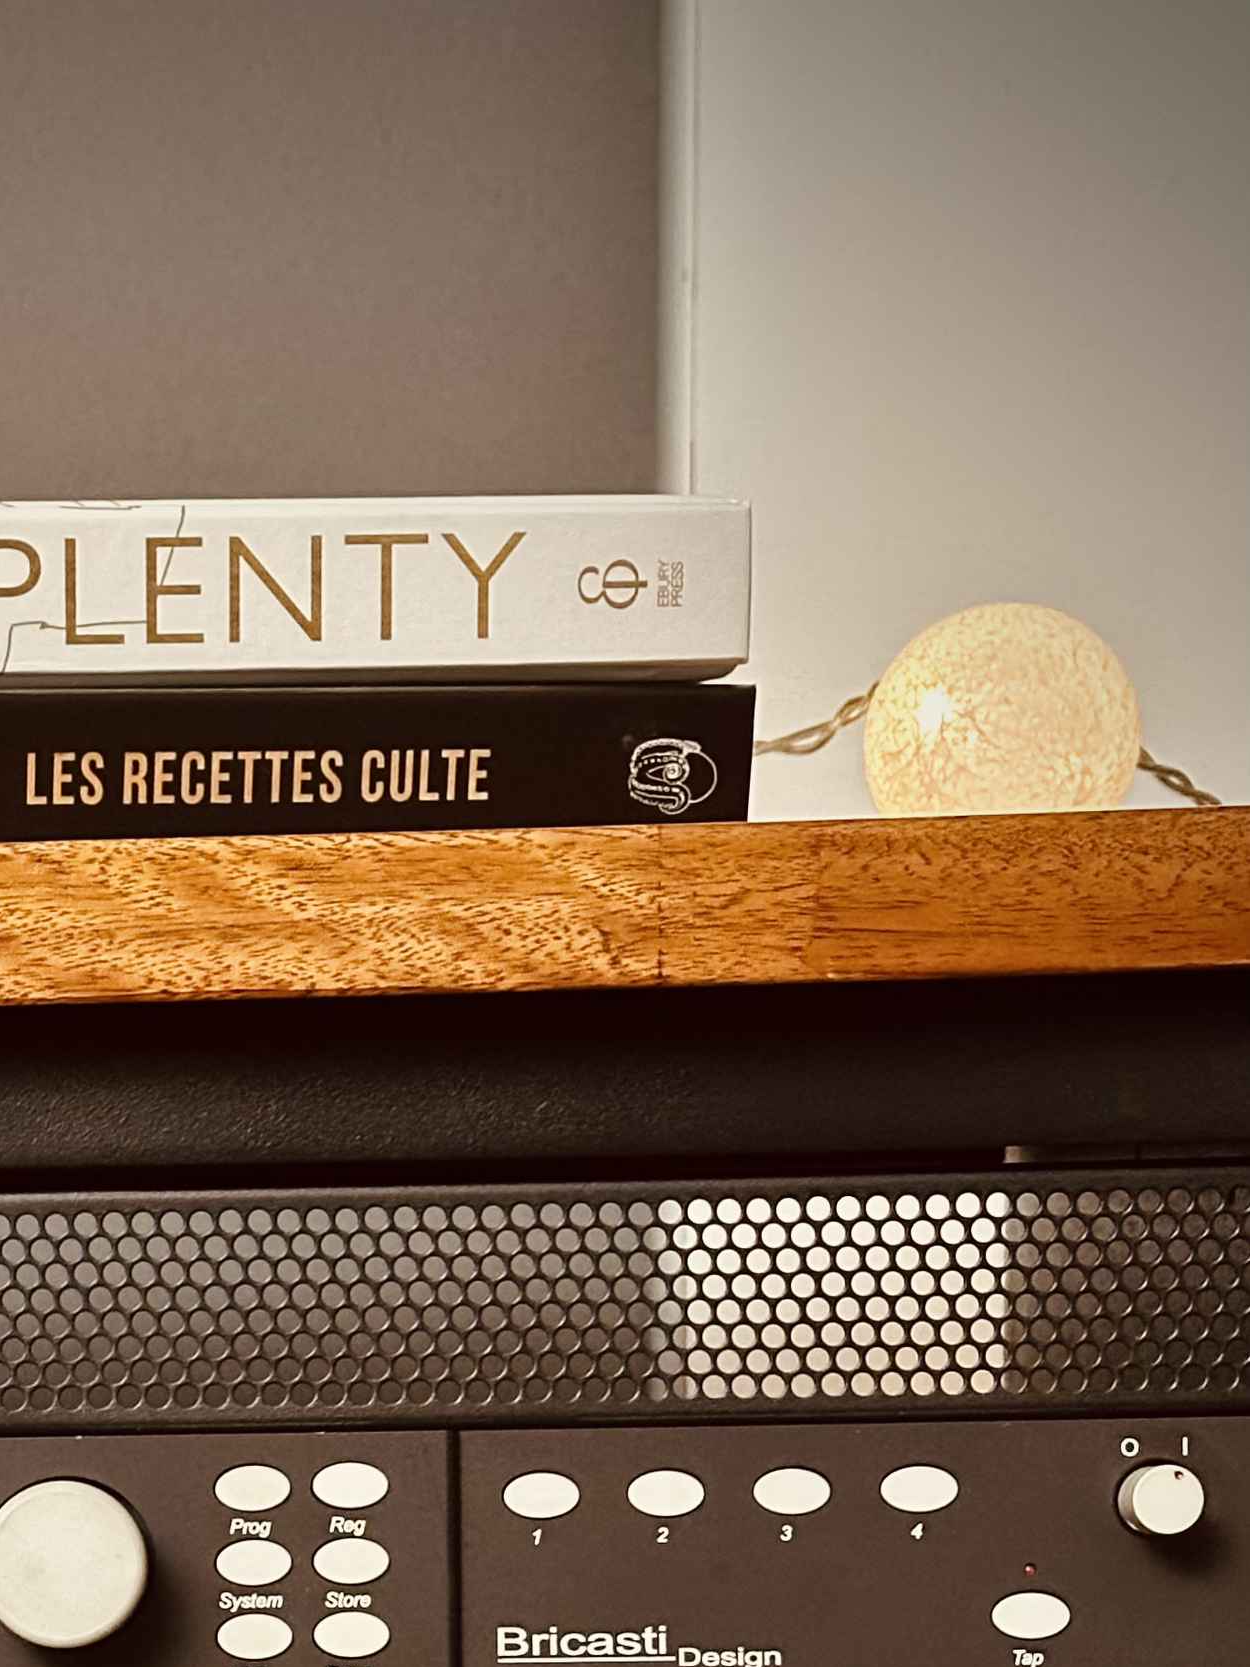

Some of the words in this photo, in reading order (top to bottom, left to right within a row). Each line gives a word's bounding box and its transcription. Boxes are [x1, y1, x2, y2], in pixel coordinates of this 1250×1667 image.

[657, 558, 670, 607] EBURY
[670, 561, 684, 607] PRESS
[25, 752, 105, 806] LES
[123, 750, 344, 805] RECETTES
[360, 748, 492, 803] CULTE
[229, 1518, 272, 1538] Prog
[329, 1516, 367, 1536] Reg
[656, 1527, 670, 1544] 2
[779, 1525, 794, 1543] 3
[910, 1523, 925, 1540] 4
[532, 1529, 543, 1546] 1
[219, 1592, 284, 1613] System
[325, 1591, 372, 1608] Store
[497, 1626, 669, 1657] Bricasti
[1012, 1649, 1044, 1667] Tap
